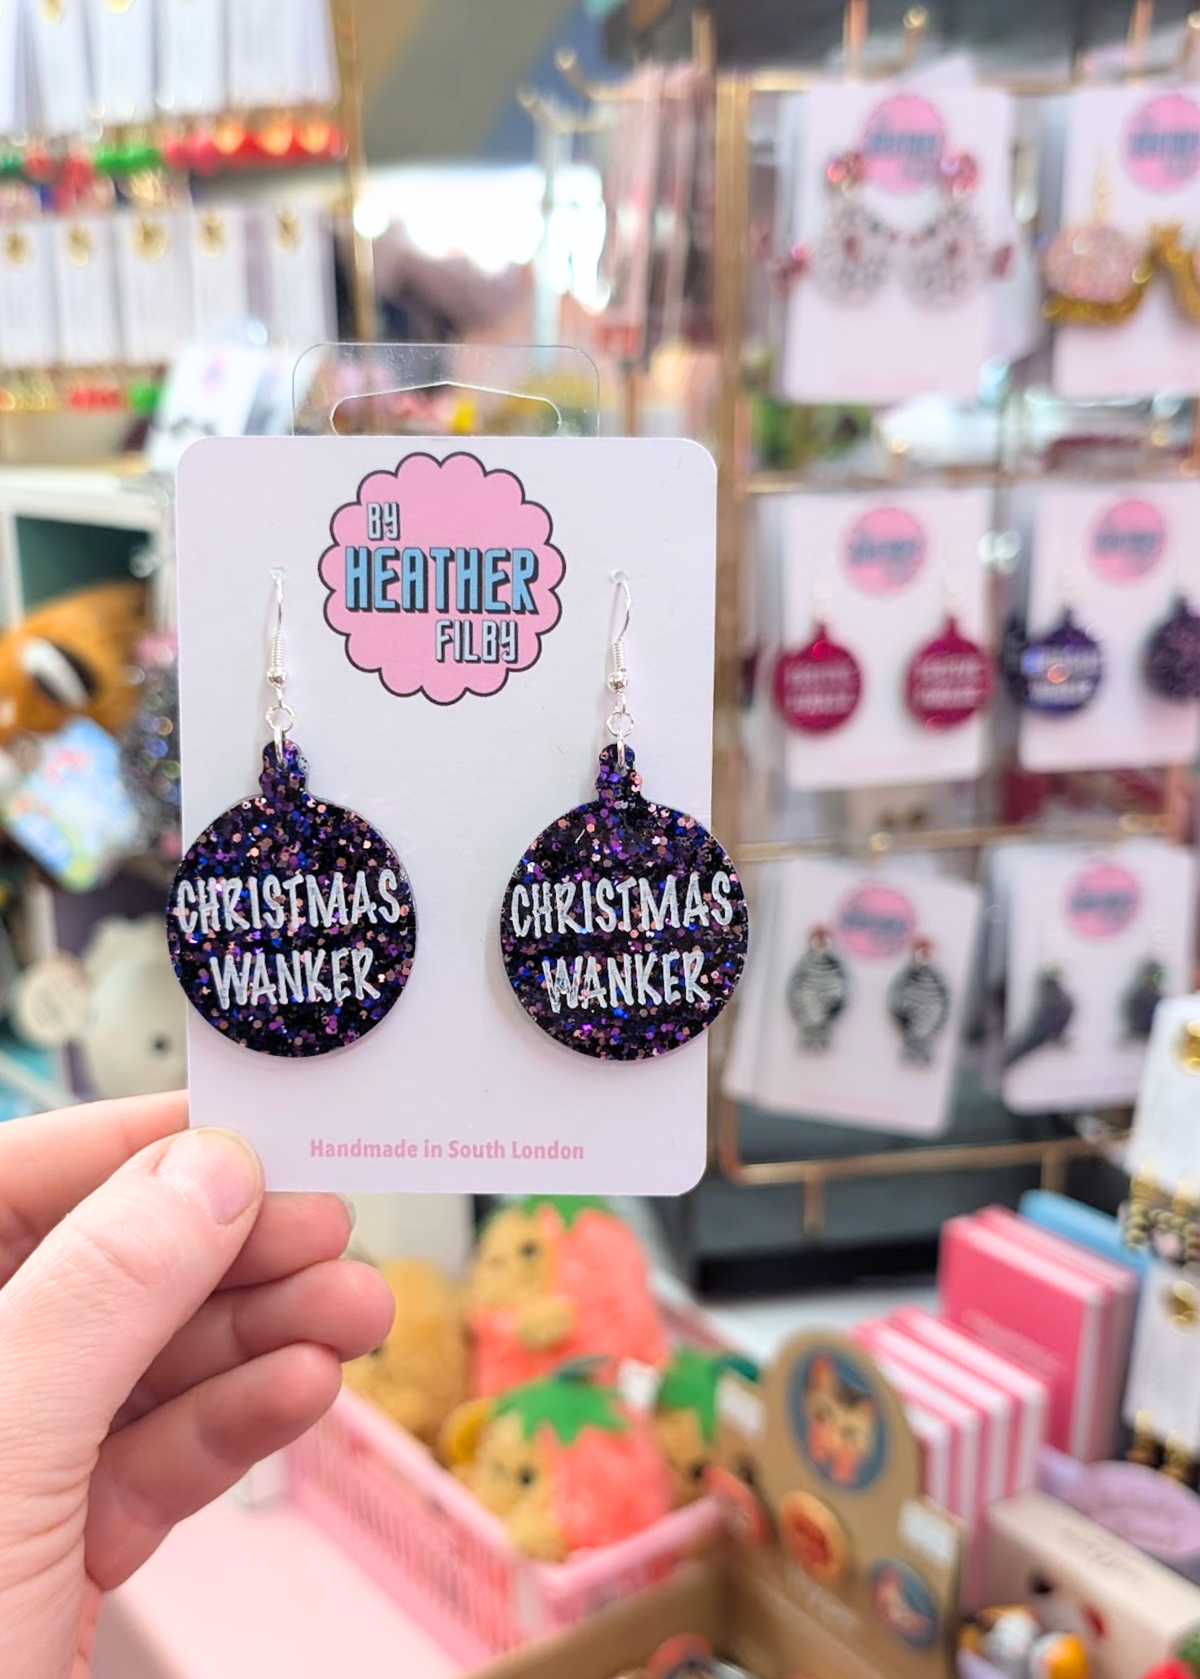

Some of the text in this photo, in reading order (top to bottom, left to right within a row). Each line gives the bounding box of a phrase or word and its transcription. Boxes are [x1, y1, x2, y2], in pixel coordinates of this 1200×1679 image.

[367, 502, 401, 541] BY
[345, 546, 539, 615] HEATHER
[435, 619, 518, 664] FILBY
[176, 869, 400, 934] CHRISTMAS
[511, 870, 734, 938] CHRISTMAS
[209, 947, 381, 1010] WANKER
[542, 951, 711, 1013] WANKER
[310, 1139, 585, 1160] Handmade in South London
